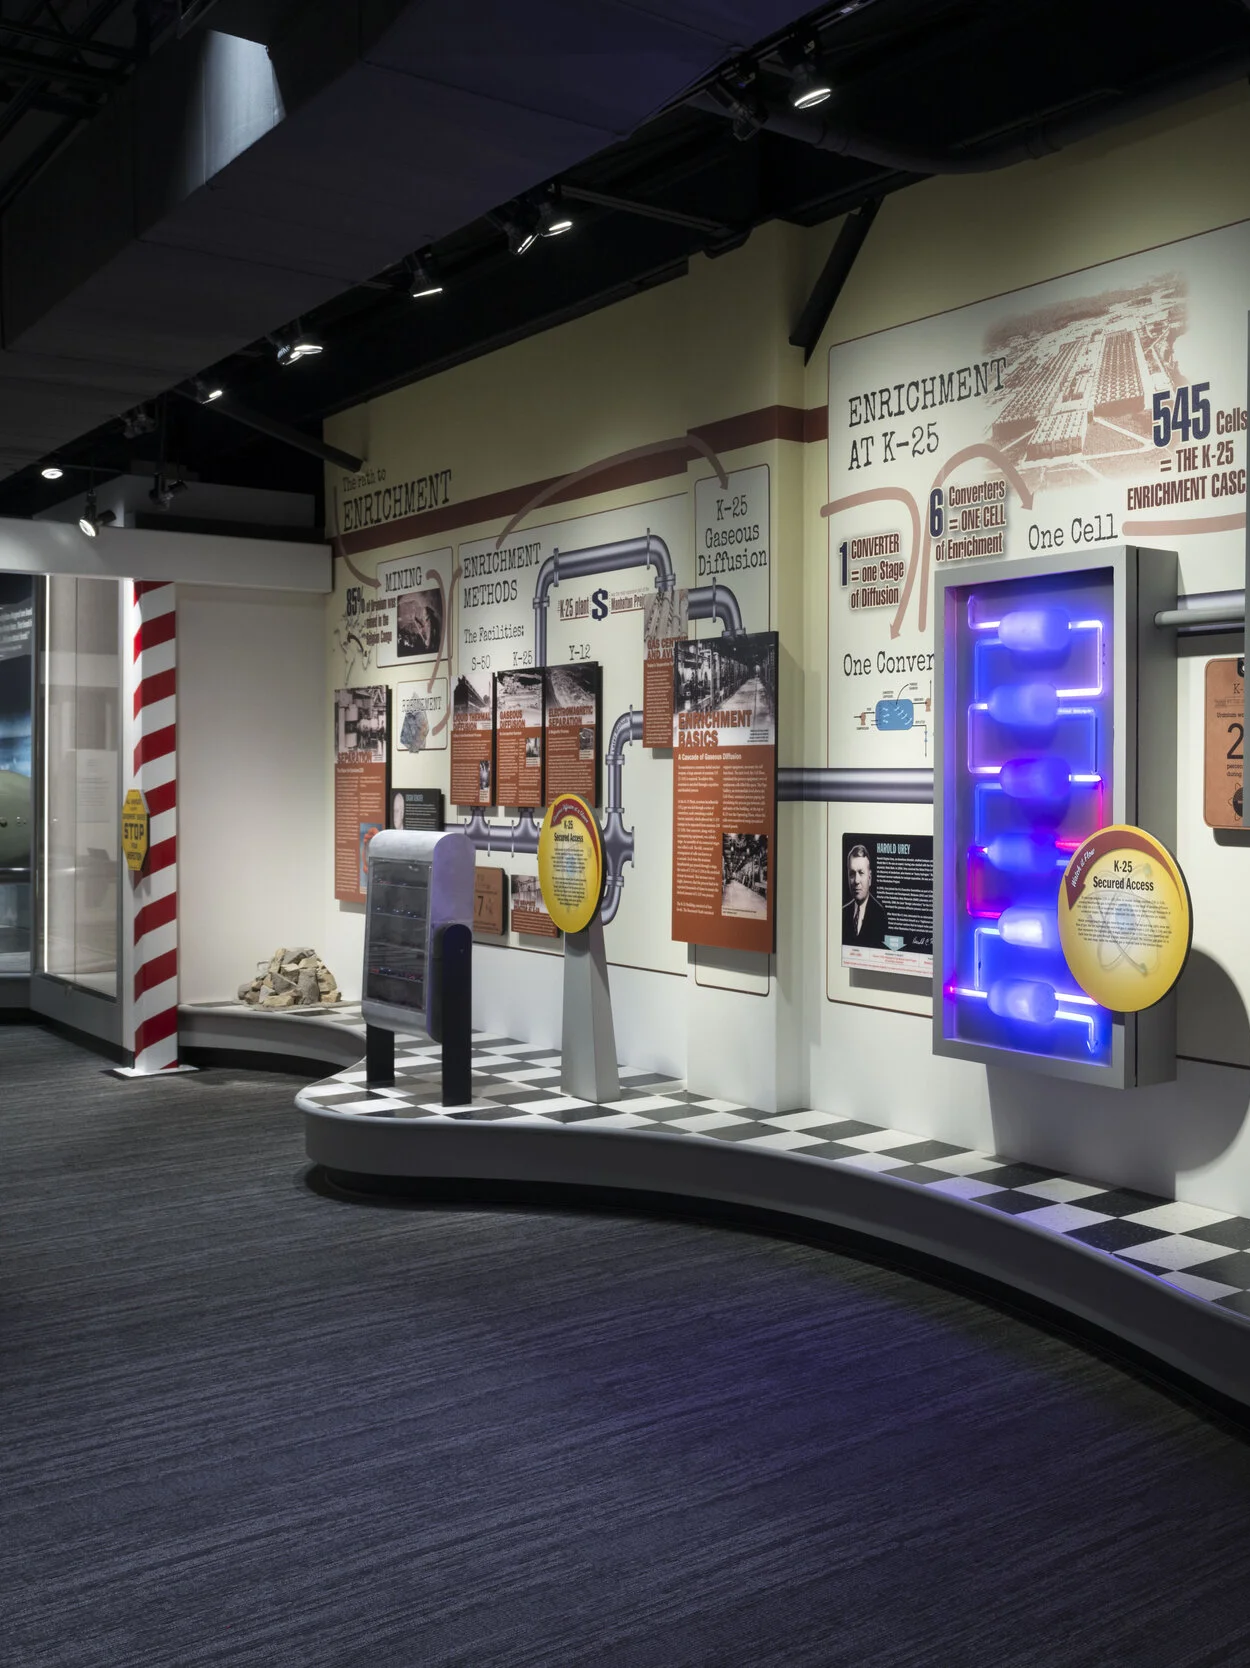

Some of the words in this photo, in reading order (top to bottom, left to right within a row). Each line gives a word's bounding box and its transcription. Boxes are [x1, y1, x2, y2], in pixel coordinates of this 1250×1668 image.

[849, 357, 1007, 428] ENRICHMENT
[1152, 382, 1211, 448] 545
[1216, 407, 1248, 435] Cells
[848, 436, 874, 471] AT
[882, 422, 940, 463] K-25
[1176, 446, 1198, 472] THE
[1202, 440, 1234, 469] K-25
[344, 469, 452, 532] ENRICHMENT
[1127, 475, 1208, 511] ENRICHMENT
[716, 494, 748, 521] K-25
[930, 488, 944, 538] 6
[949, 480, 1005, 507] Converters
[961, 508, 980, 532] ONE
[983, 504, 1006, 528] CELL
[706, 524, 760, 548] Gaseous
[1028, 524, 1064, 550] One
[1071, 514, 1118, 544] Cell
[840, 542, 848, 586] 1
[851, 533, 900, 560] CONVERTER
[936, 541, 945, 561] of
[948, 532, 1003, 560] Enrichment
[464, 542, 542, 579] ENRICHMENT
[698, 548, 767, 576] Diffusion
[862, 564, 877, 582] one
[880, 560, 904, 582] Stage
[385, 566, 422, 592] MINING
[464, 580, 518, 608] METHODS
[592, 588, 608, 622] $
[851, 588, 860, 608] of
[862, 586, 899, 608] Diffusion
[464, 628, 478, 644] The
[479, 624, 524, 643] Facilities:
[472, 655, 490, 670] S-50
[512, 650, 532, 666] K-25
[569, 644, 592, 660] Y-12
[843, 653, 872, 676] One
[876, 650, 934, 674] Conver
[678, 709, 752, 730] ENRICHMENT
[678, 730, 718, 748] BASICS
[1226, 722, 1244, 760] 2
[722, 752, 742, 760] Diffusion
[124, 822, 144, 840] STOP
[554, 832, 570, 842] Secured
[570, 833, 584, 843] Access
[564, 820, 574, 830] K-25
[876, 842, 896, 854] HAROLD
[898, 844, 910, 854] UREY
[1114, 860, 1132, 873] K-25
[1093, 876, 1124, 890] Secured
[1126, 878, 1154, 892] Access
